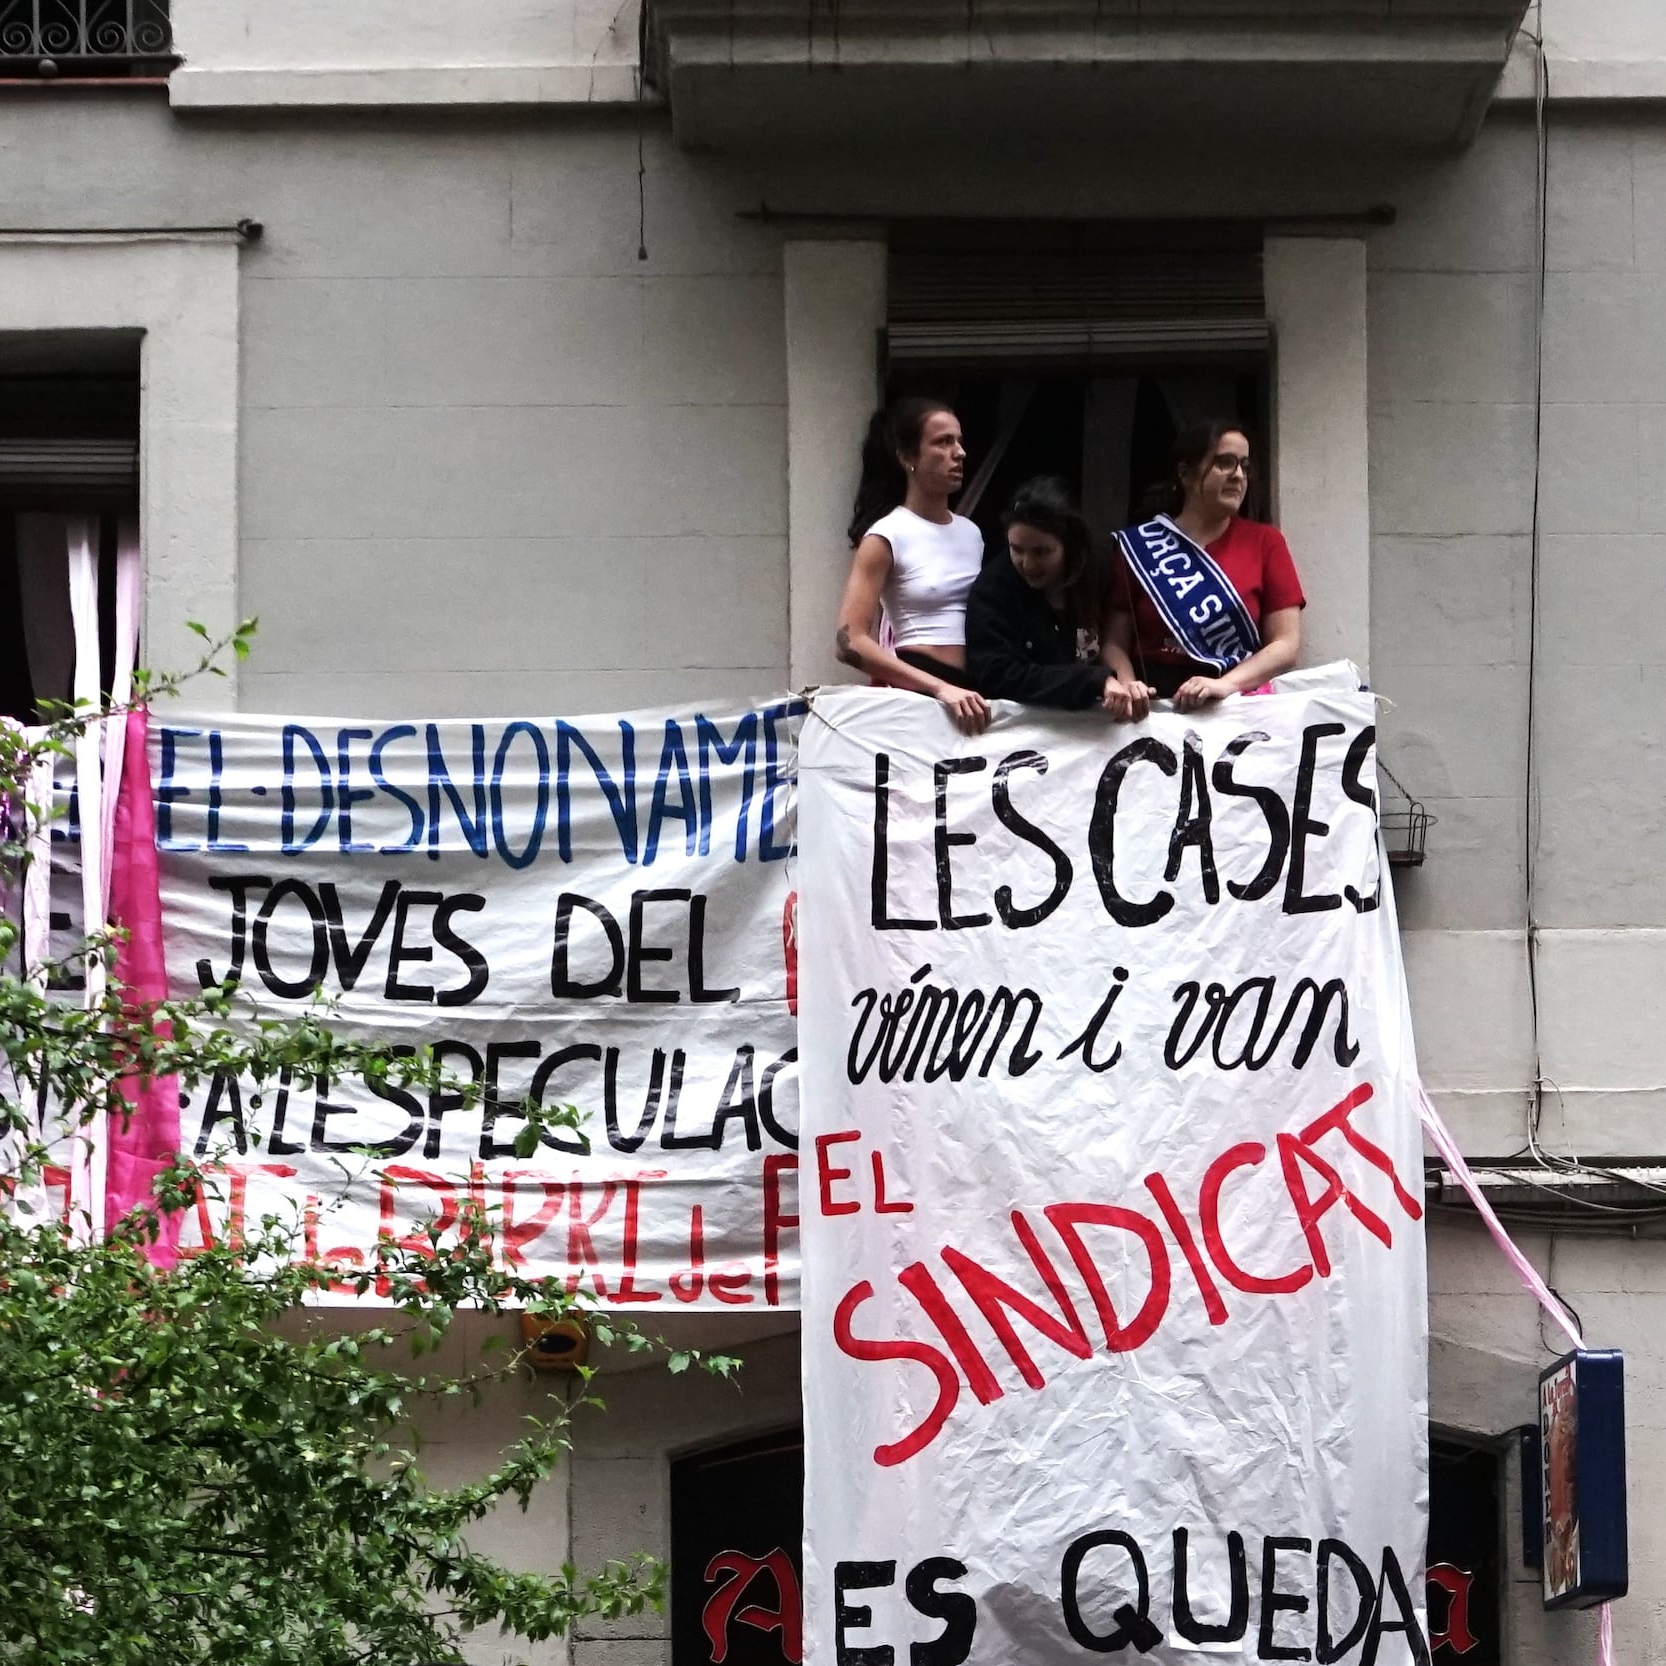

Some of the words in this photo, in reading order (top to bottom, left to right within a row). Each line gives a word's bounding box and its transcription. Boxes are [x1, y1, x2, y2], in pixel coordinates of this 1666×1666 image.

[872, 748, 1073, 931] LES
[1088, 722, 1382, 928] CASES
[195, 874, 490, 1006] JOVES
[550, 887, 741, 1004] DEL
[1059, 966, 1128, 1074] i
[1164, 975, 1360, 1072] van
[815, 1130, 914, 1217] EL
[833, 1082, 1424, 1469] SINDICAT
